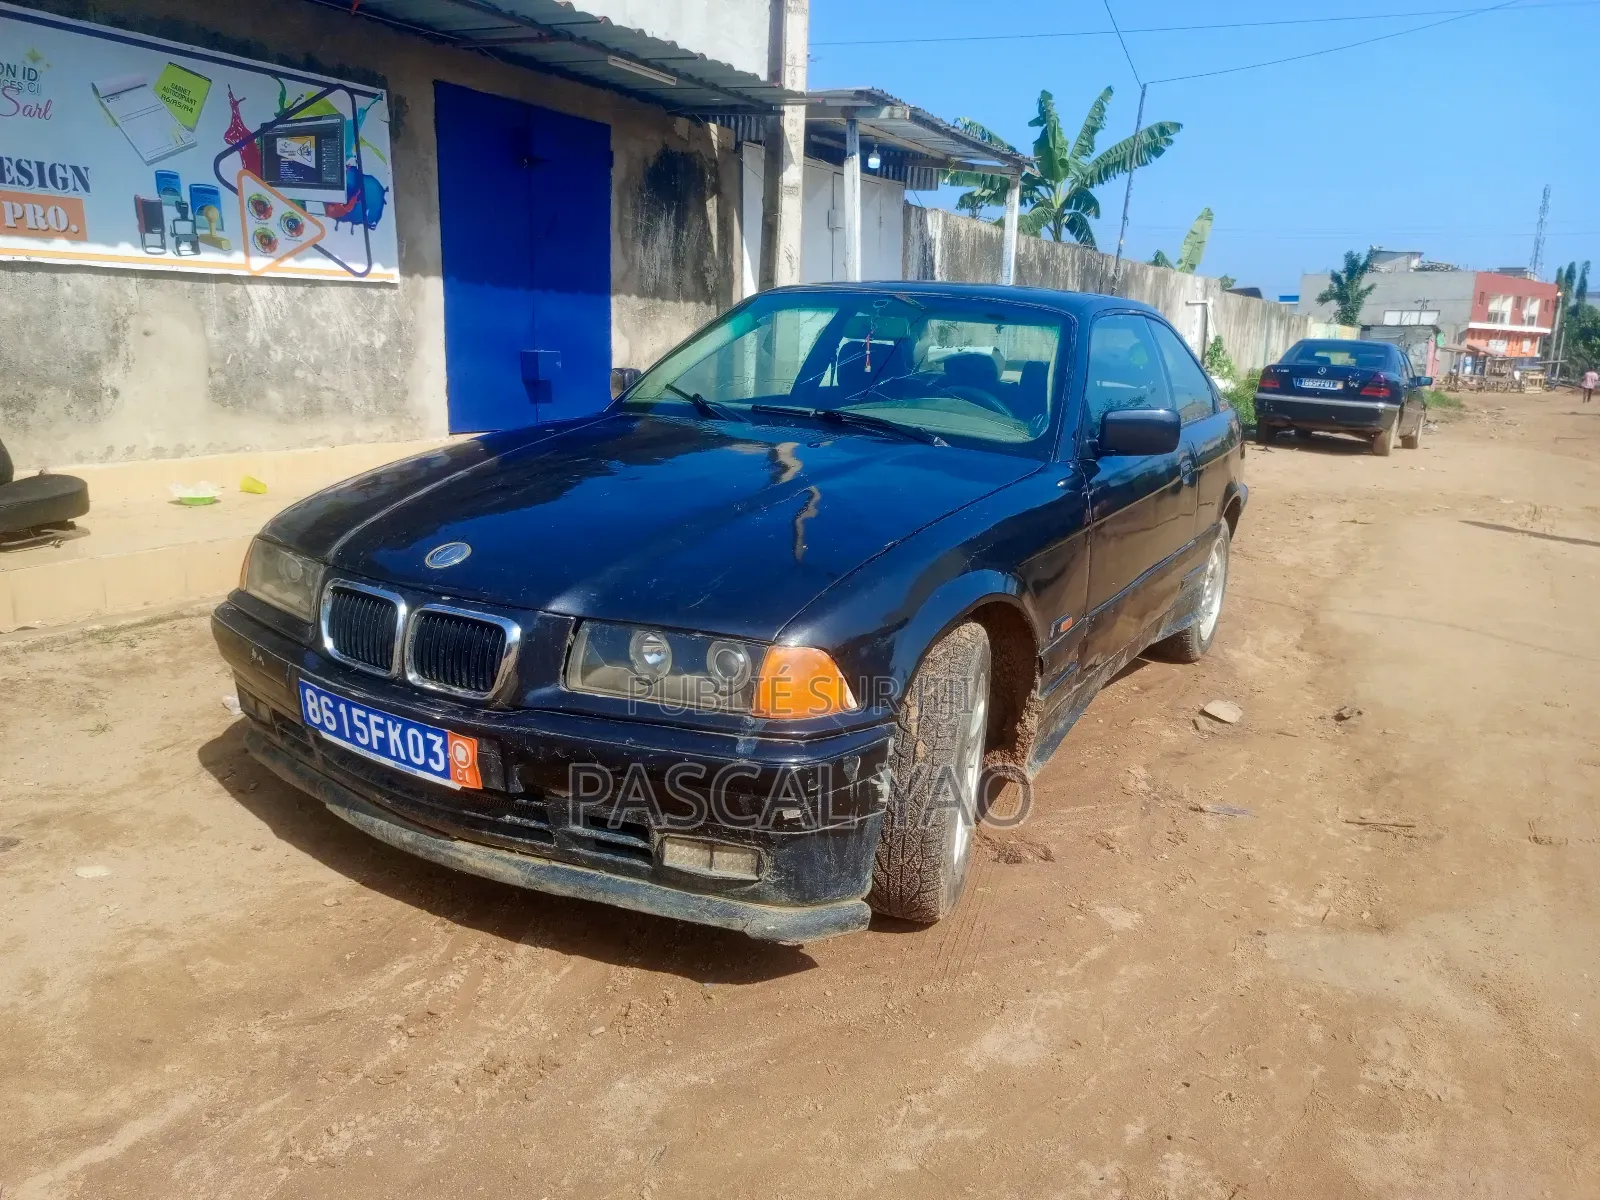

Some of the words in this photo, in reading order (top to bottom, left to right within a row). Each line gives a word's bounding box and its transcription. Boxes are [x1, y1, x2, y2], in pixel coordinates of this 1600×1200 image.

[0, 85, 53, 121] Sarl
[2, 201, 79, 234] PRO.
[304, 688, 446, 773] 8615FK03
